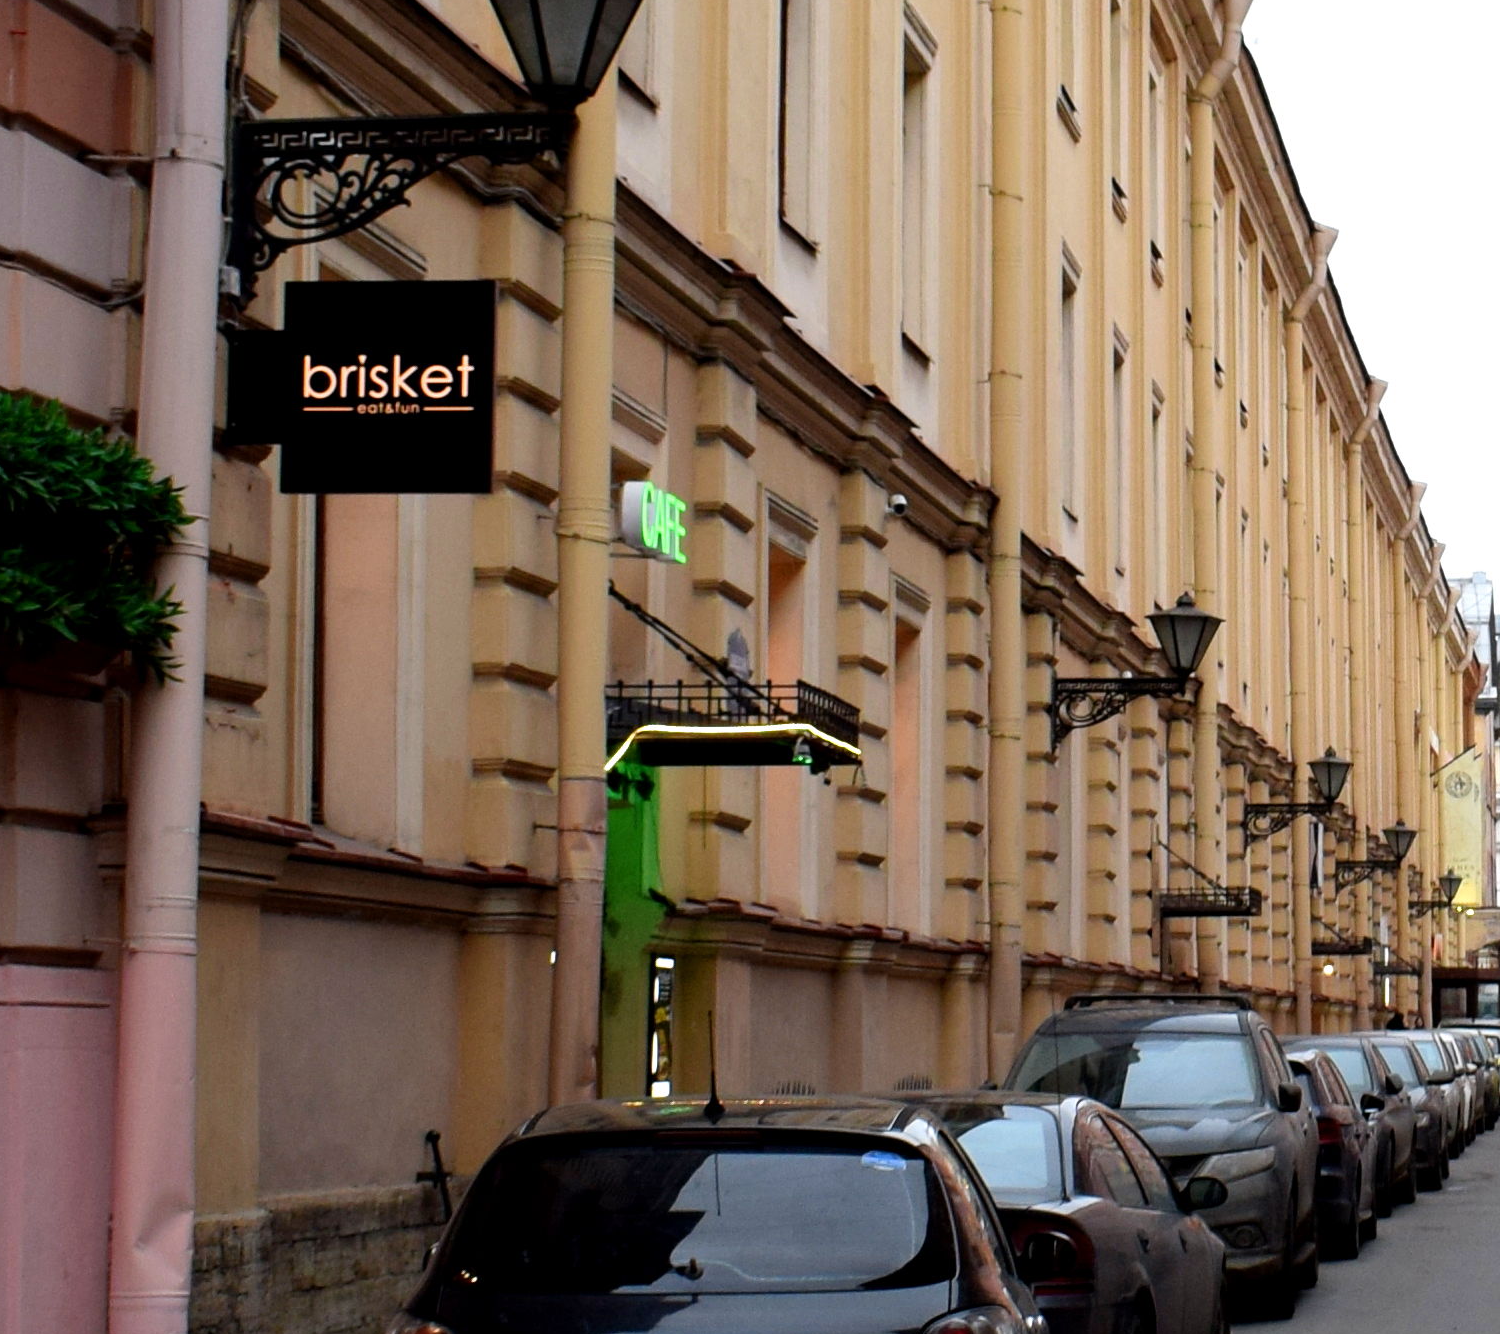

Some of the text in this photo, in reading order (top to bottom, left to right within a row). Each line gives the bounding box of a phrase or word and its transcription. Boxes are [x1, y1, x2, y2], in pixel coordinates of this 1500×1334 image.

[303, 354, 475, 399] brisket
[357, 402, 420, 414] eat&fun
[642, 481, 687, 564] CAFE
